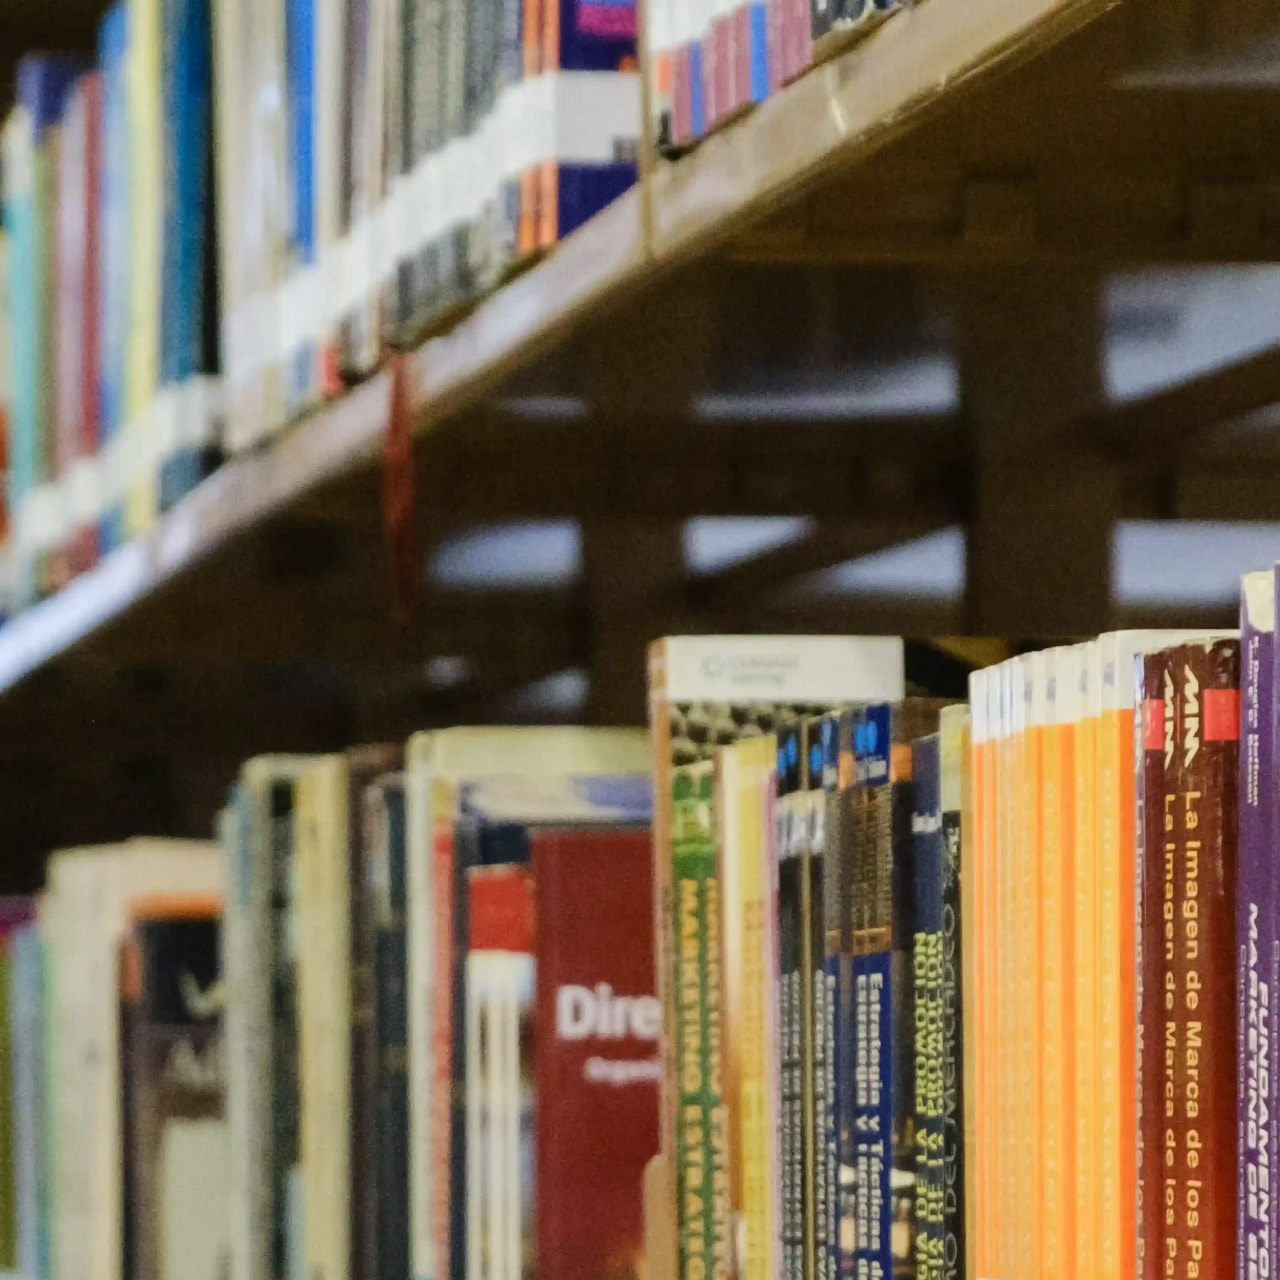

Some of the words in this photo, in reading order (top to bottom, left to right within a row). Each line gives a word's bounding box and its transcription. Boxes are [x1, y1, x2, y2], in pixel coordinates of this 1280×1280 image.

[1165, 794, 1176, 831] La
[1184, 790, 1201, 829] La
[1163, 843, 1176, 962] Imagen
[1181, 840, 1201, 960] Imagen
[681, 878, 702, 1092] MARKETING
[1165, 971, 1177, 1010] de
[1184, 970, 1202, 1009] de
[869, 972, 884, 1106] Estrategia
[1248, 902, 1258, 1149] MARKETING
[1165, 1020, 1176, 1119] Marca
[1184, 1020, 1201, 1118] Marca
[869, 1114, 881, 1133] y
[915, 1128, 928, 1164] LA
[1166, 1129, 1177, 1168] de
[1185, 1129, 1202, 1168] de
[870, 1139, 885, 1251] Tácticas
[915, 1177, 928, 1219] DE
[945, 1143, 957, 1213] DEL
[1247, 1162, 1258, 1220] DE
[1166, 1179, 1177, 1226] los
[1186, 1179, 1202, 1227] los
